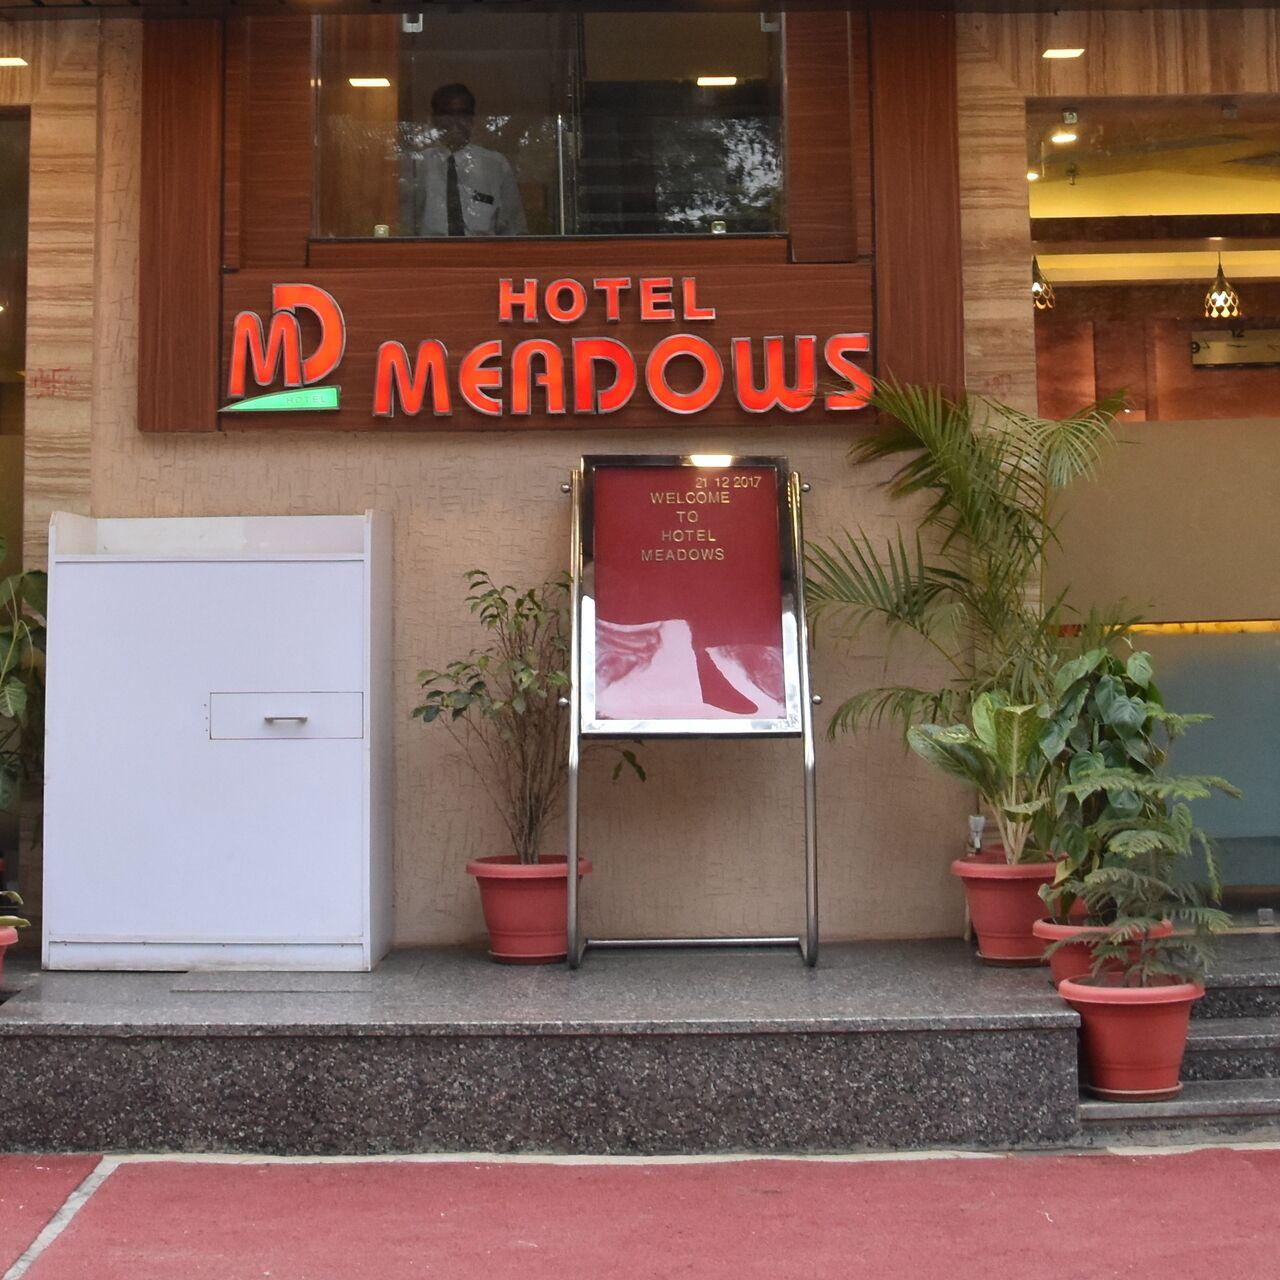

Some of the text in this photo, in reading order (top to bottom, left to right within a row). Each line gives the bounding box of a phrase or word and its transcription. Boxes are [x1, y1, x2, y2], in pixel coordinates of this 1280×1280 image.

[498, 277, 717, 323] HOTEL
[227, 282, 347, 399] MD
[372, 332, 874, 418] MEADOWS
[286, 395, 327, 404] HOTEL
[695, 476, 762, 489] 21 12 2017
[650, 492, 731, 504] WELCOME
[676, 511, 699, 523] TO
[662, 530, 717, 542] HOTEL
[641, 548, 725, 561] MEADOWS
